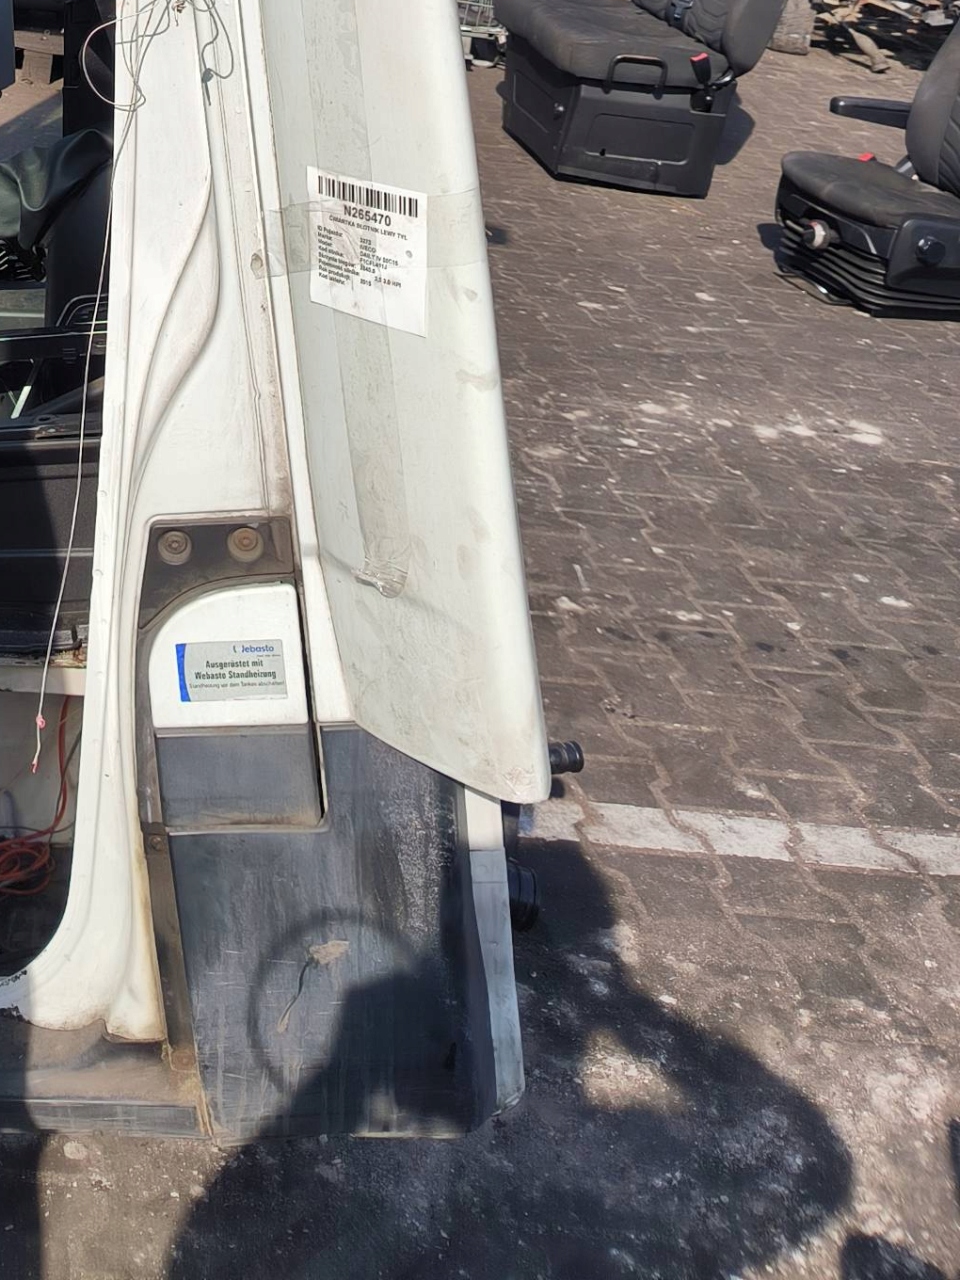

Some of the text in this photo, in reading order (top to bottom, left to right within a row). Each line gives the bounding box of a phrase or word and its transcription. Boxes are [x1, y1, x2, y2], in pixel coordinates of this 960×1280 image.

[343, 205, 392, 227] N265470
[360, 244, 377, 254] IVECO
[206, 659, 264, 670] Ausgerüstet mit
[194, 669, 277, 680] Webasto Standheizung
